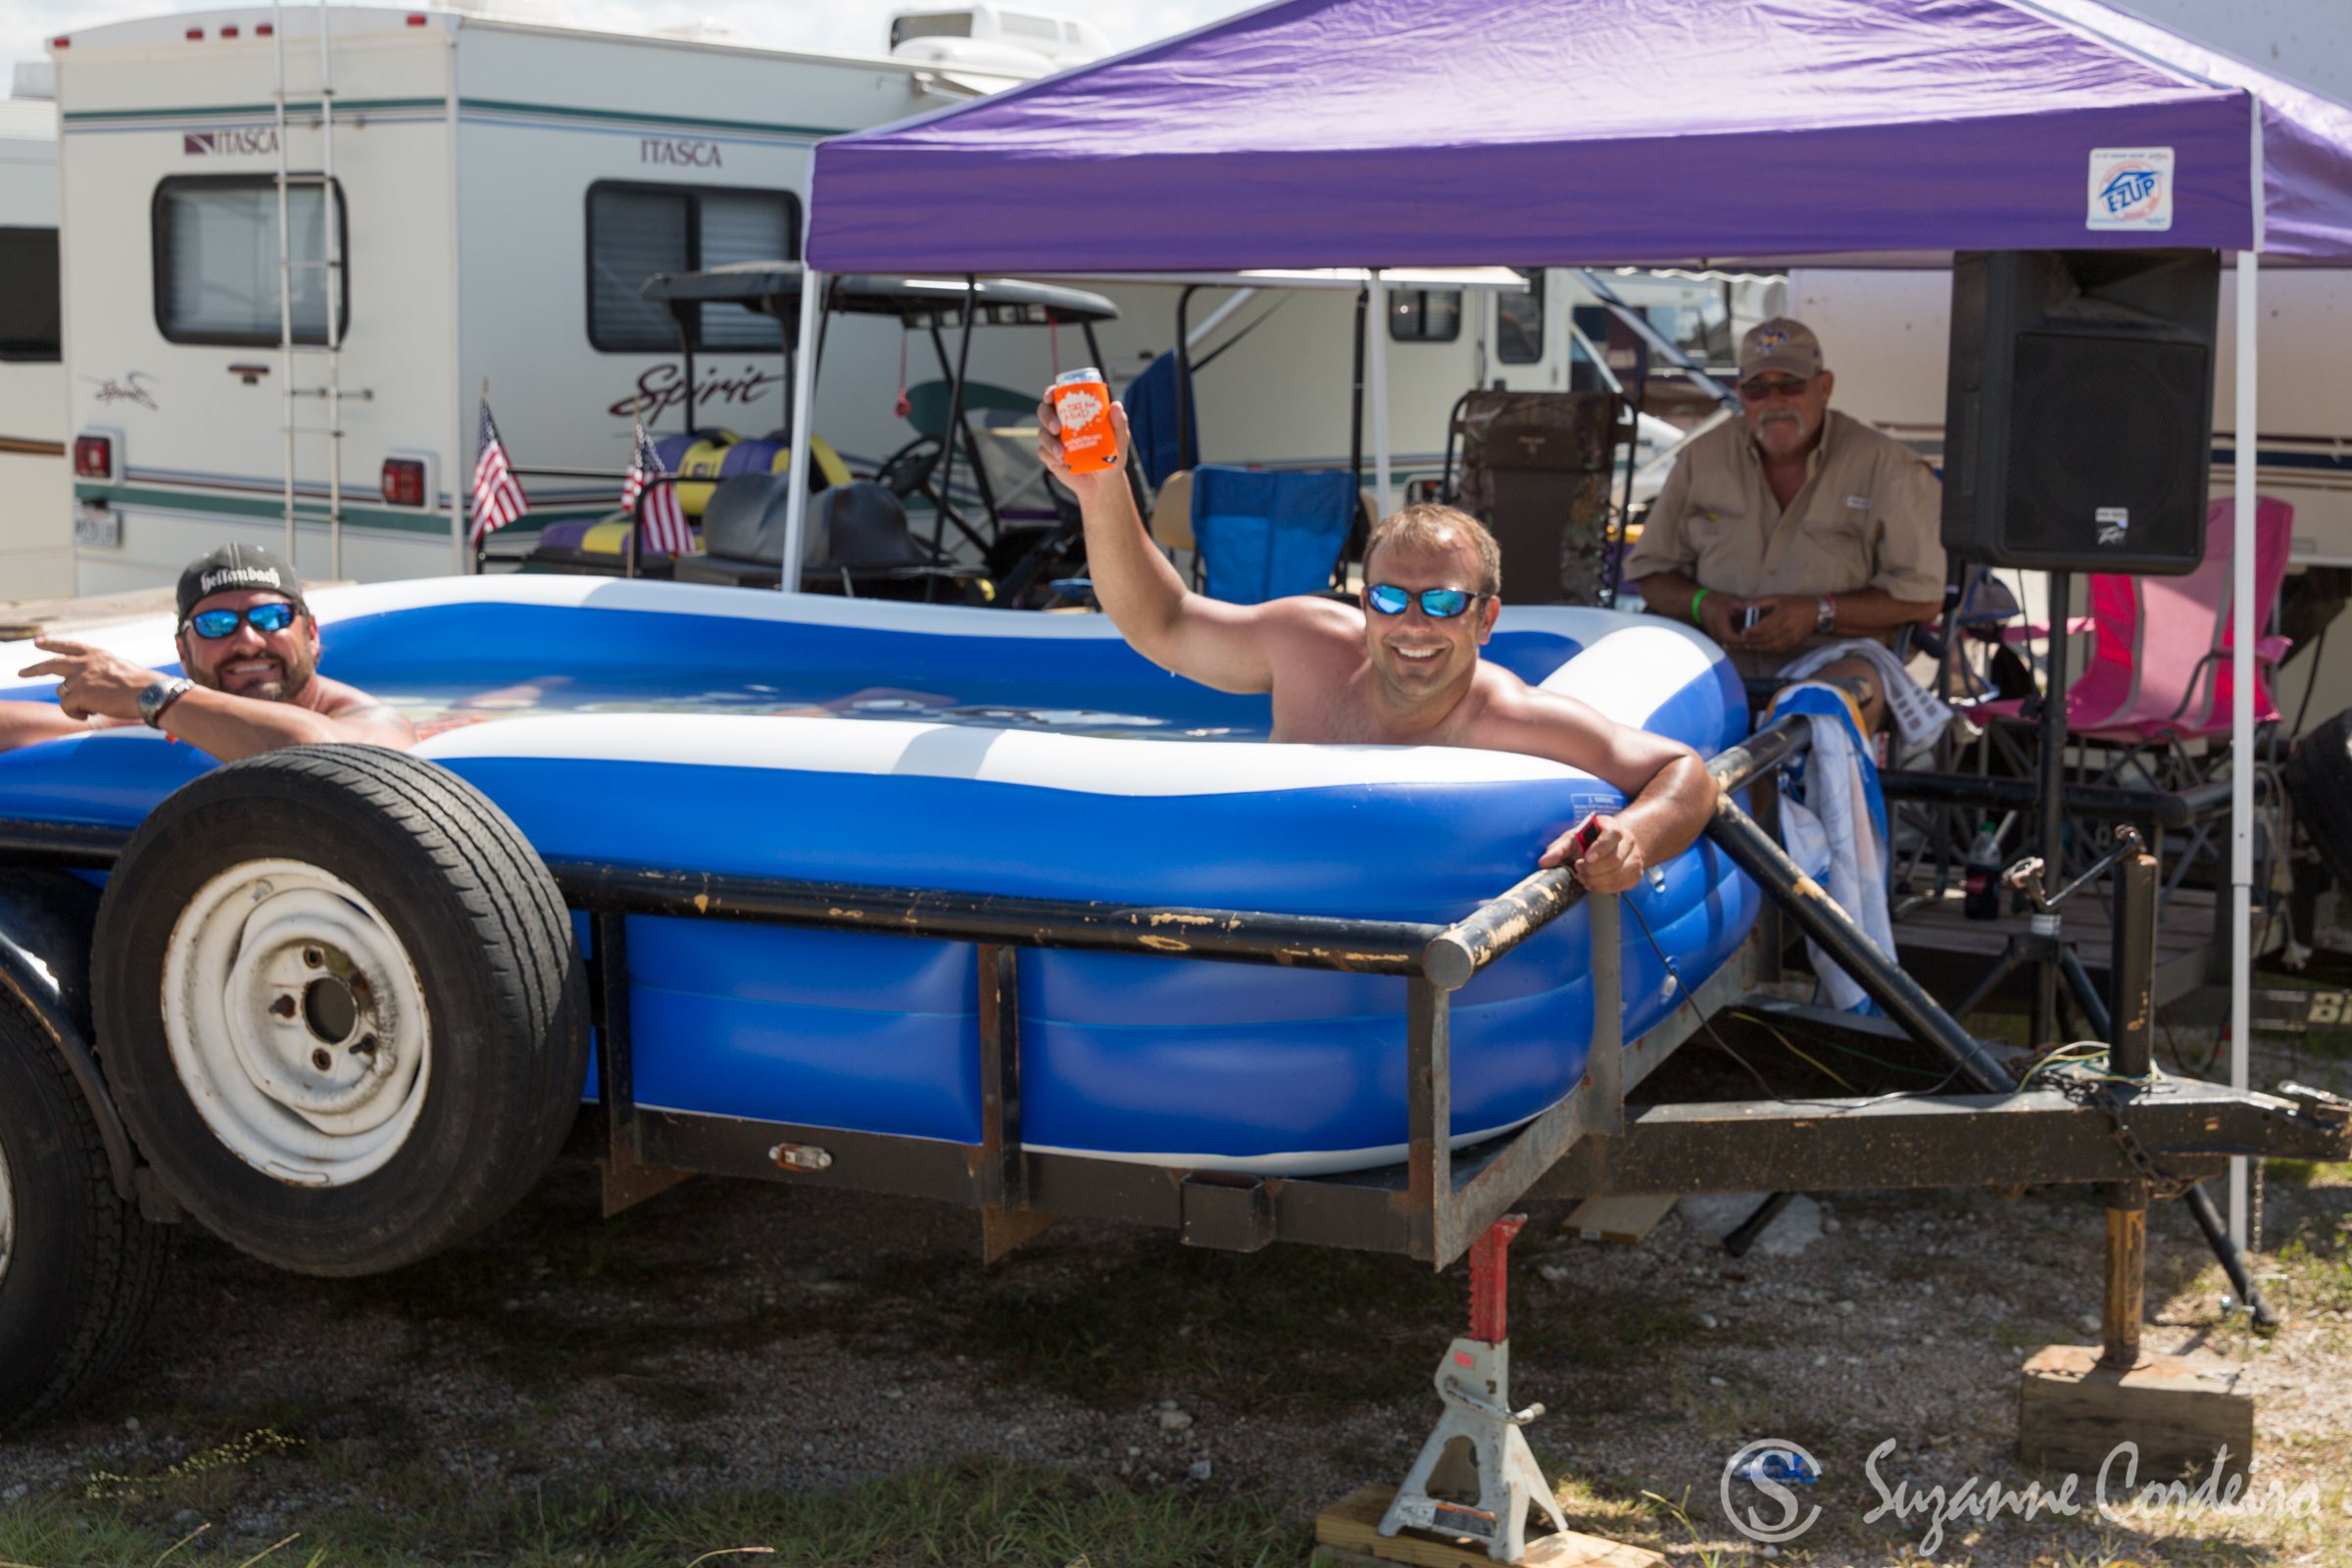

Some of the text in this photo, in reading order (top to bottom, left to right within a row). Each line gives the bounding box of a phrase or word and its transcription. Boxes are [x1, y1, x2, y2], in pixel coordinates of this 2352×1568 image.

[216, 129, 279, 155] ITASCA
[640, 138, 723, 169] ITASCA
[608, 363, 785, 427] Spirit
